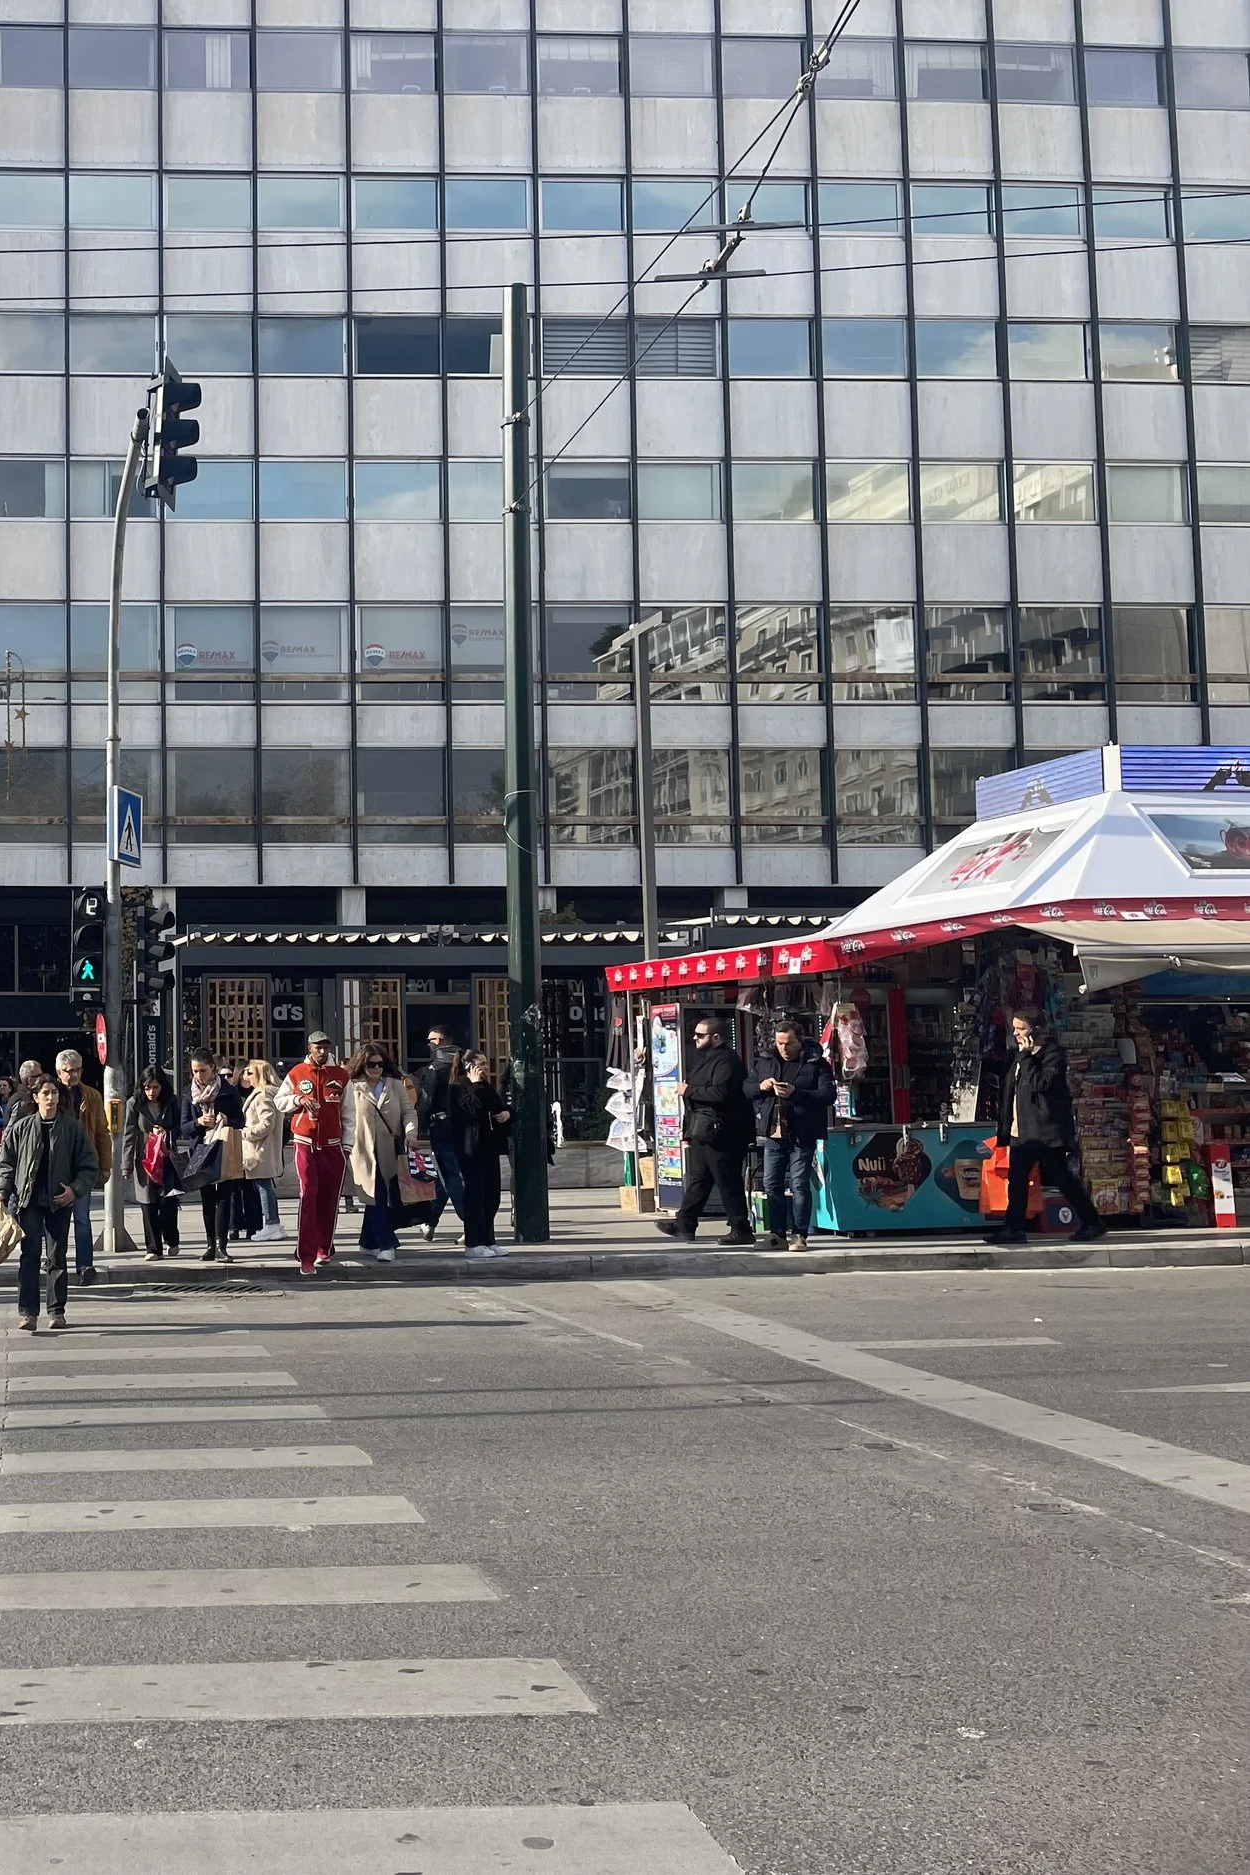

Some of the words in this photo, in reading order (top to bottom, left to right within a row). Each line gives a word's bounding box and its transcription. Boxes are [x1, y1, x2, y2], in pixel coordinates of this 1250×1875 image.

[469, 628, 505, 637] RE/MAX
[281, 645, 316, 654] RE/MAX
[199, 651, 236, 661] RE/MAX
[388, 650, 426, 661] RE/MAX
[146, 1024, 157, 1065] onald's
